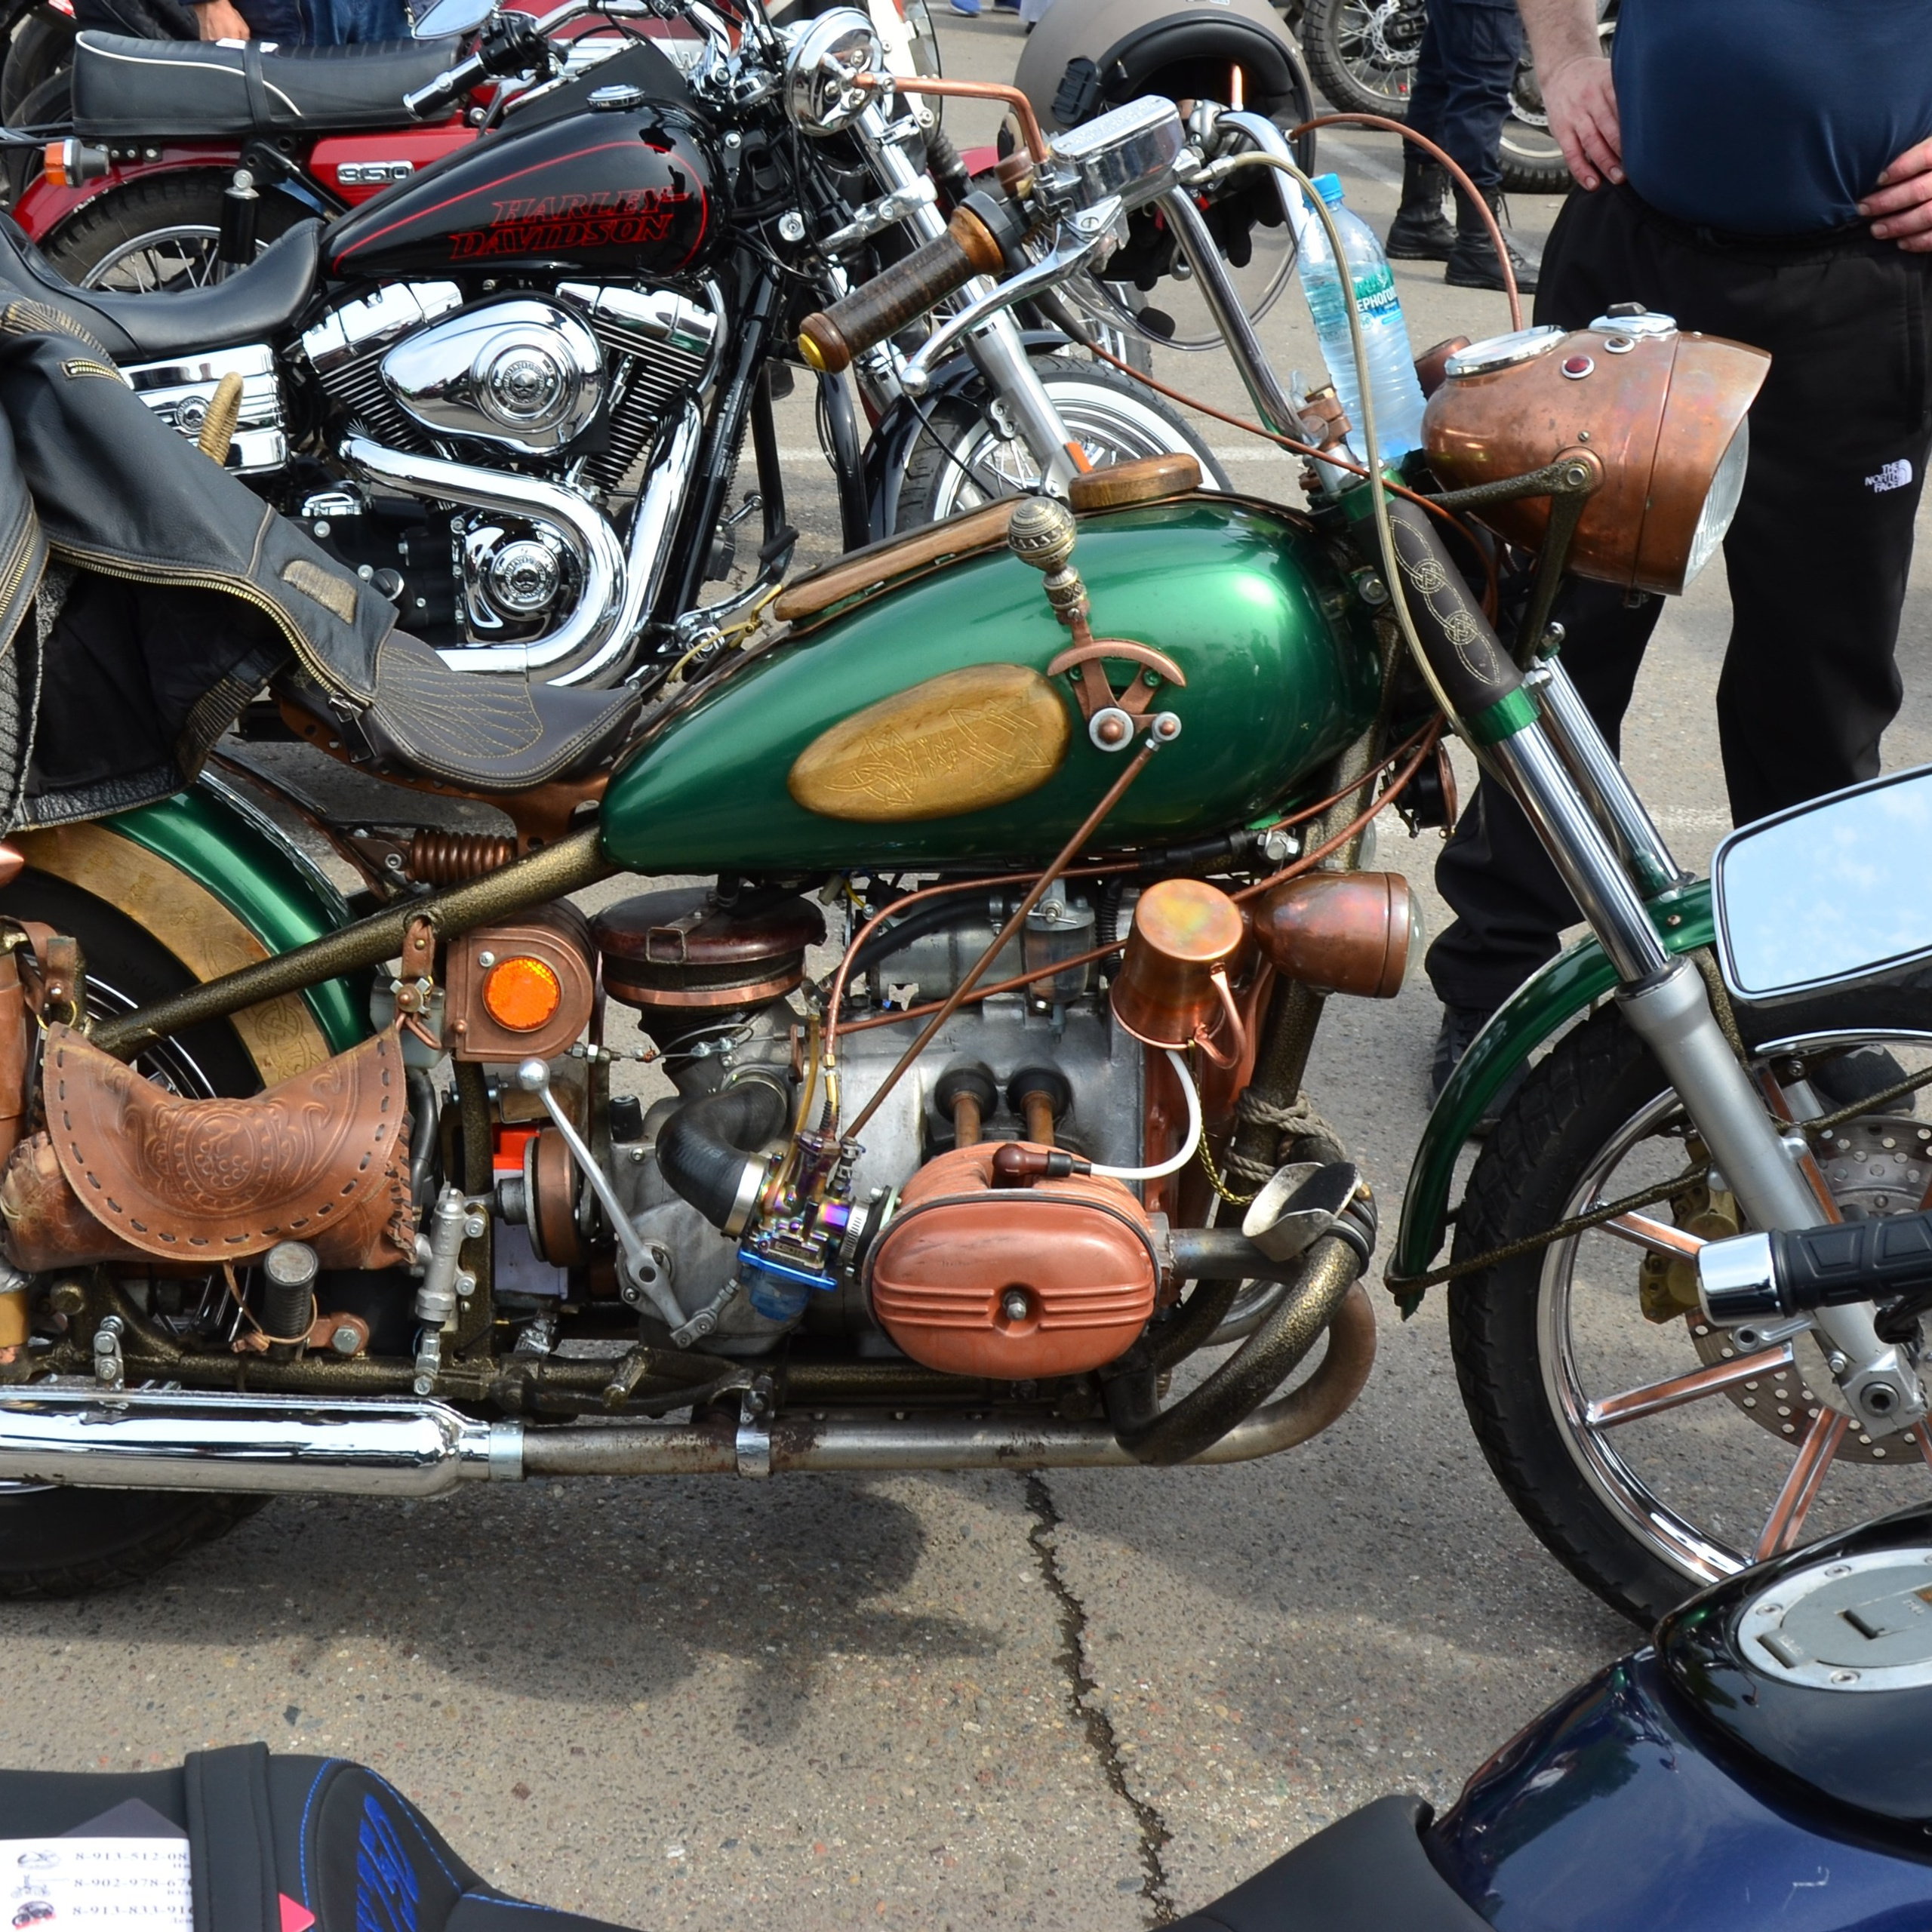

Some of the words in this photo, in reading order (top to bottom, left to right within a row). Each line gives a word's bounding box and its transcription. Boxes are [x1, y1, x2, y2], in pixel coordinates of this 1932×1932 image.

[448, 214, 674, 259] DAVIDSON
[1357, 286, 1398, 312] ЕРНОГО
[1882, 462, 1899, 474] THE
[1865, 470, 1899, 486] NORTH
[1874, 480, 1899, 493] FACE
